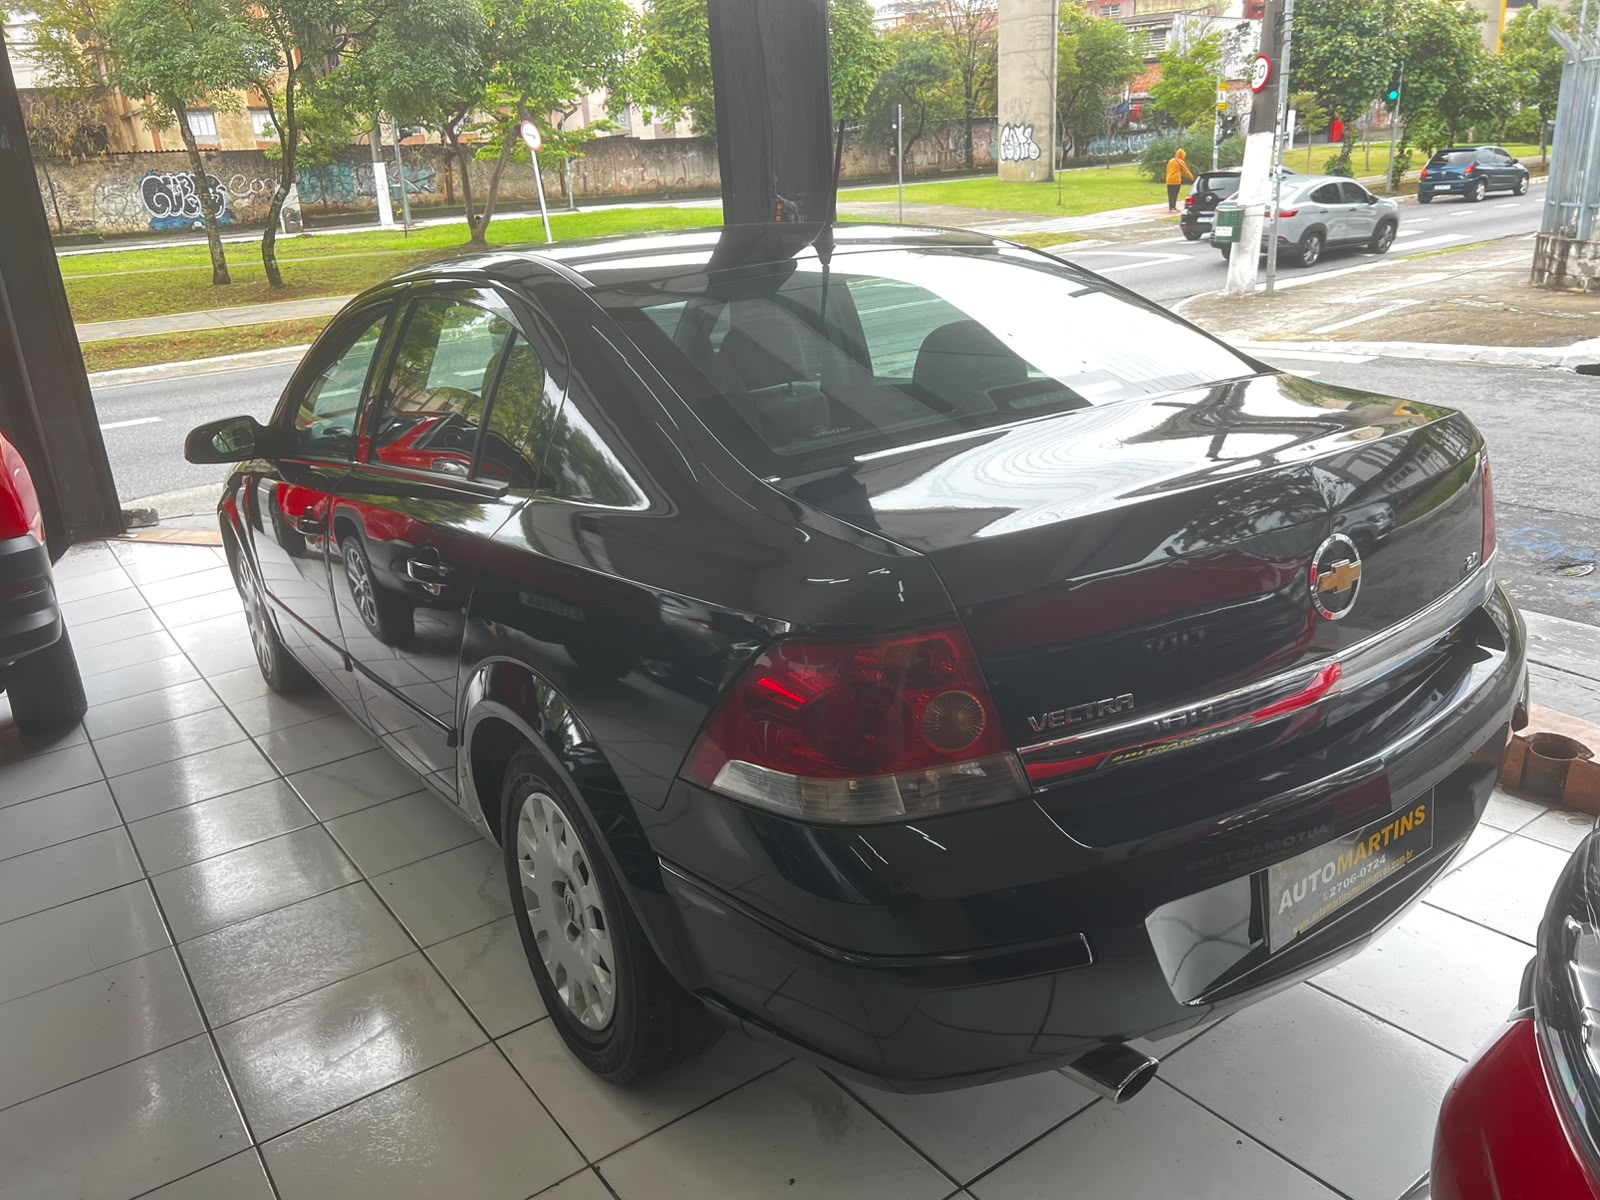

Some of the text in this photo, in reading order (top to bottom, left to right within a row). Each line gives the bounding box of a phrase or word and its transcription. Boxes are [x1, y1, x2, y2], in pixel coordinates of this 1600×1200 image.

[1027, 692, 1135, 732] VECTRA
[1278, 804, 1426, 914] AUTOMARTINS
[1329, 854, 1387, 898] 2706-0724
